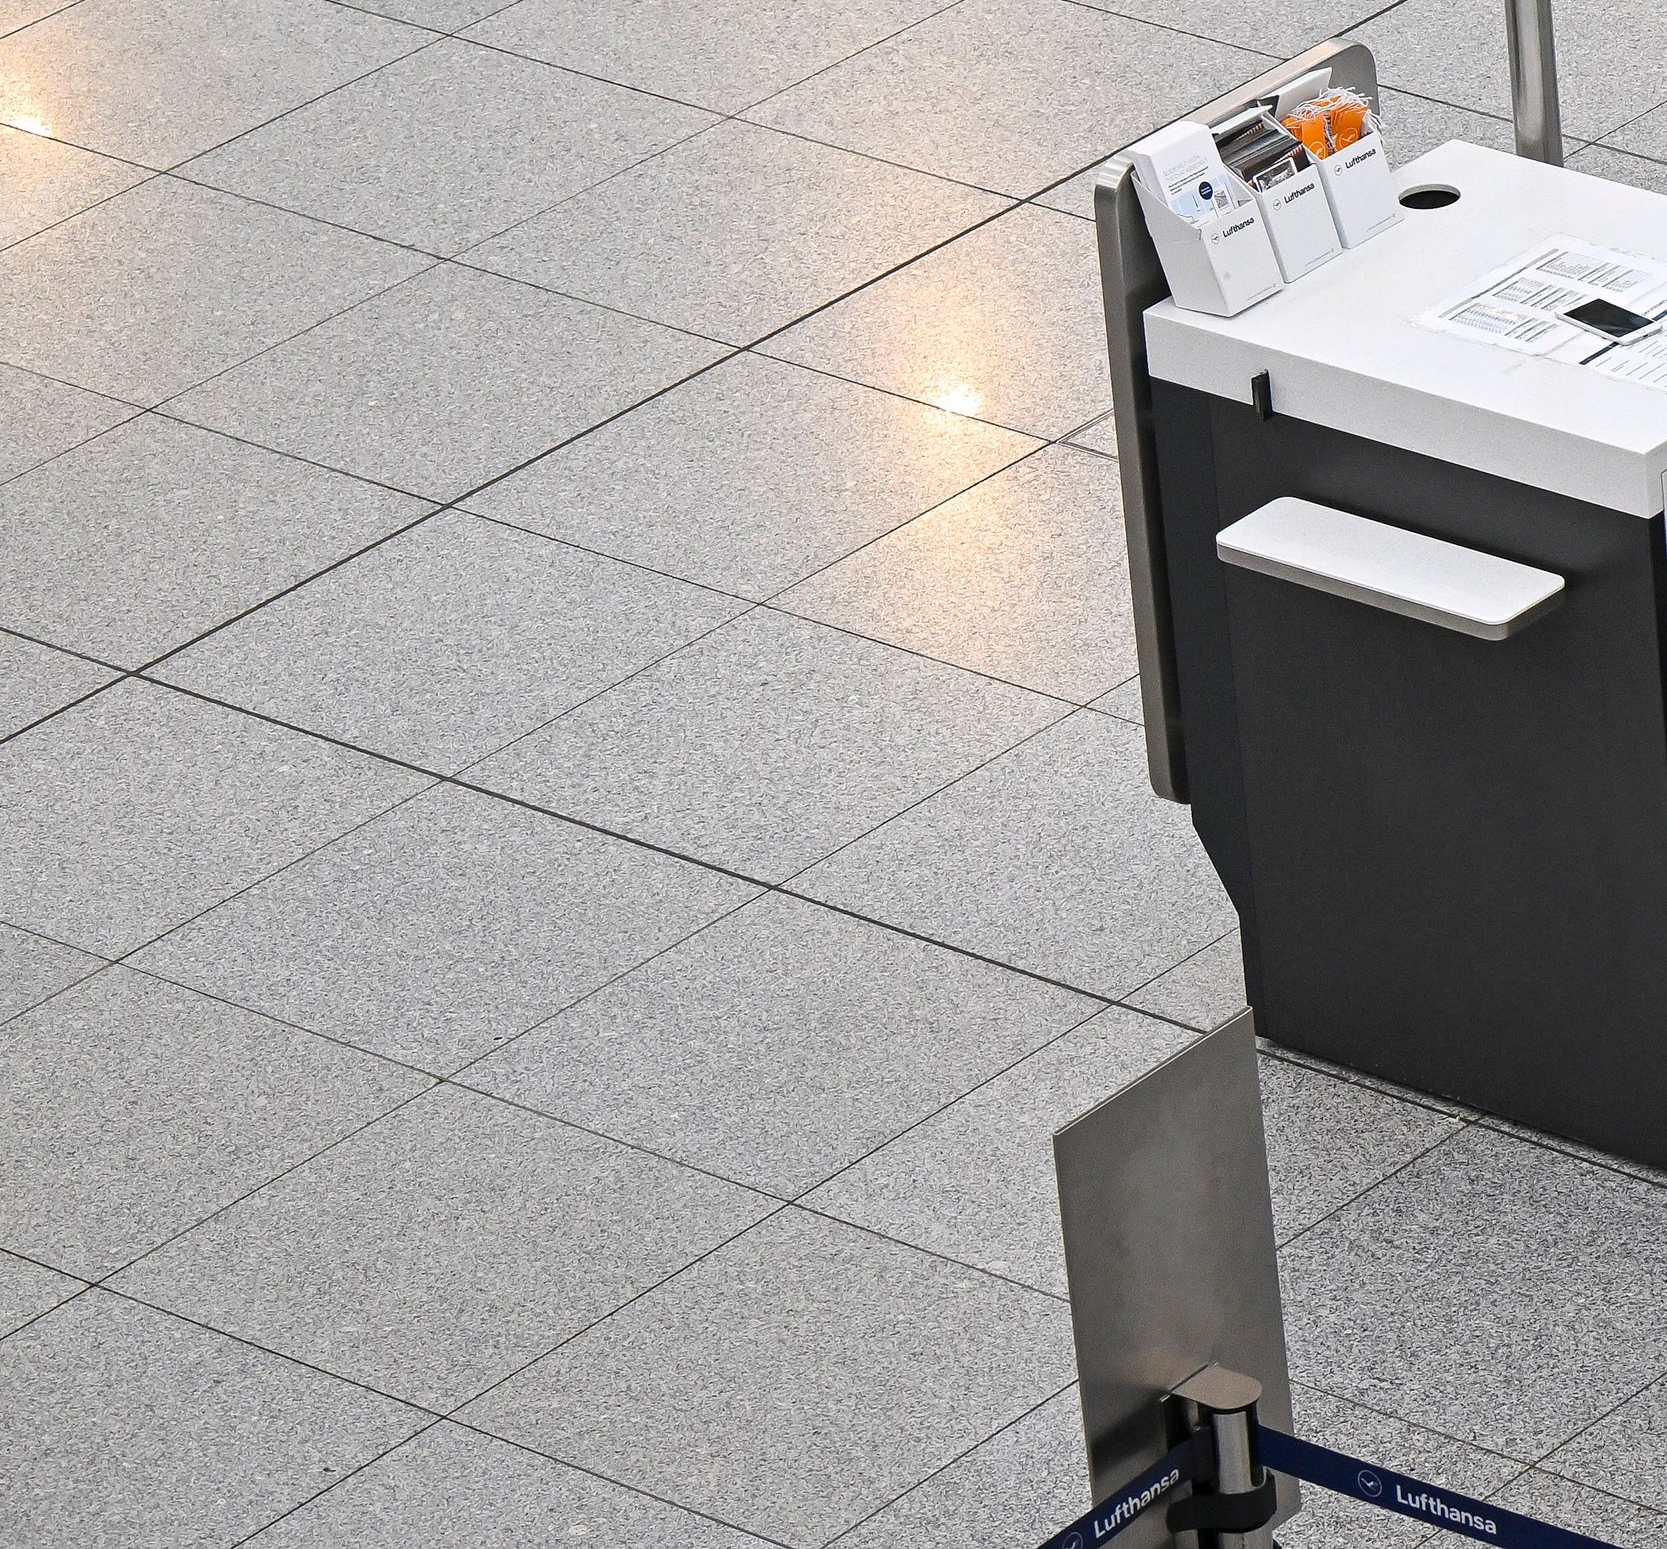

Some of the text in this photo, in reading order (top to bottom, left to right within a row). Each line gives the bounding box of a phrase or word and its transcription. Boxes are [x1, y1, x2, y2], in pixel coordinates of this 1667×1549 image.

[1344, 148, 1376, 169] Lufthansa
[1283, 183, 1315, 204] Lufthansa
[1222, 217, 1255, 238] Lufthansa
[1094, 1467, 1180, 1538] Lufthansa
[1396, 1484, 1497, 1535] Lufthansa
